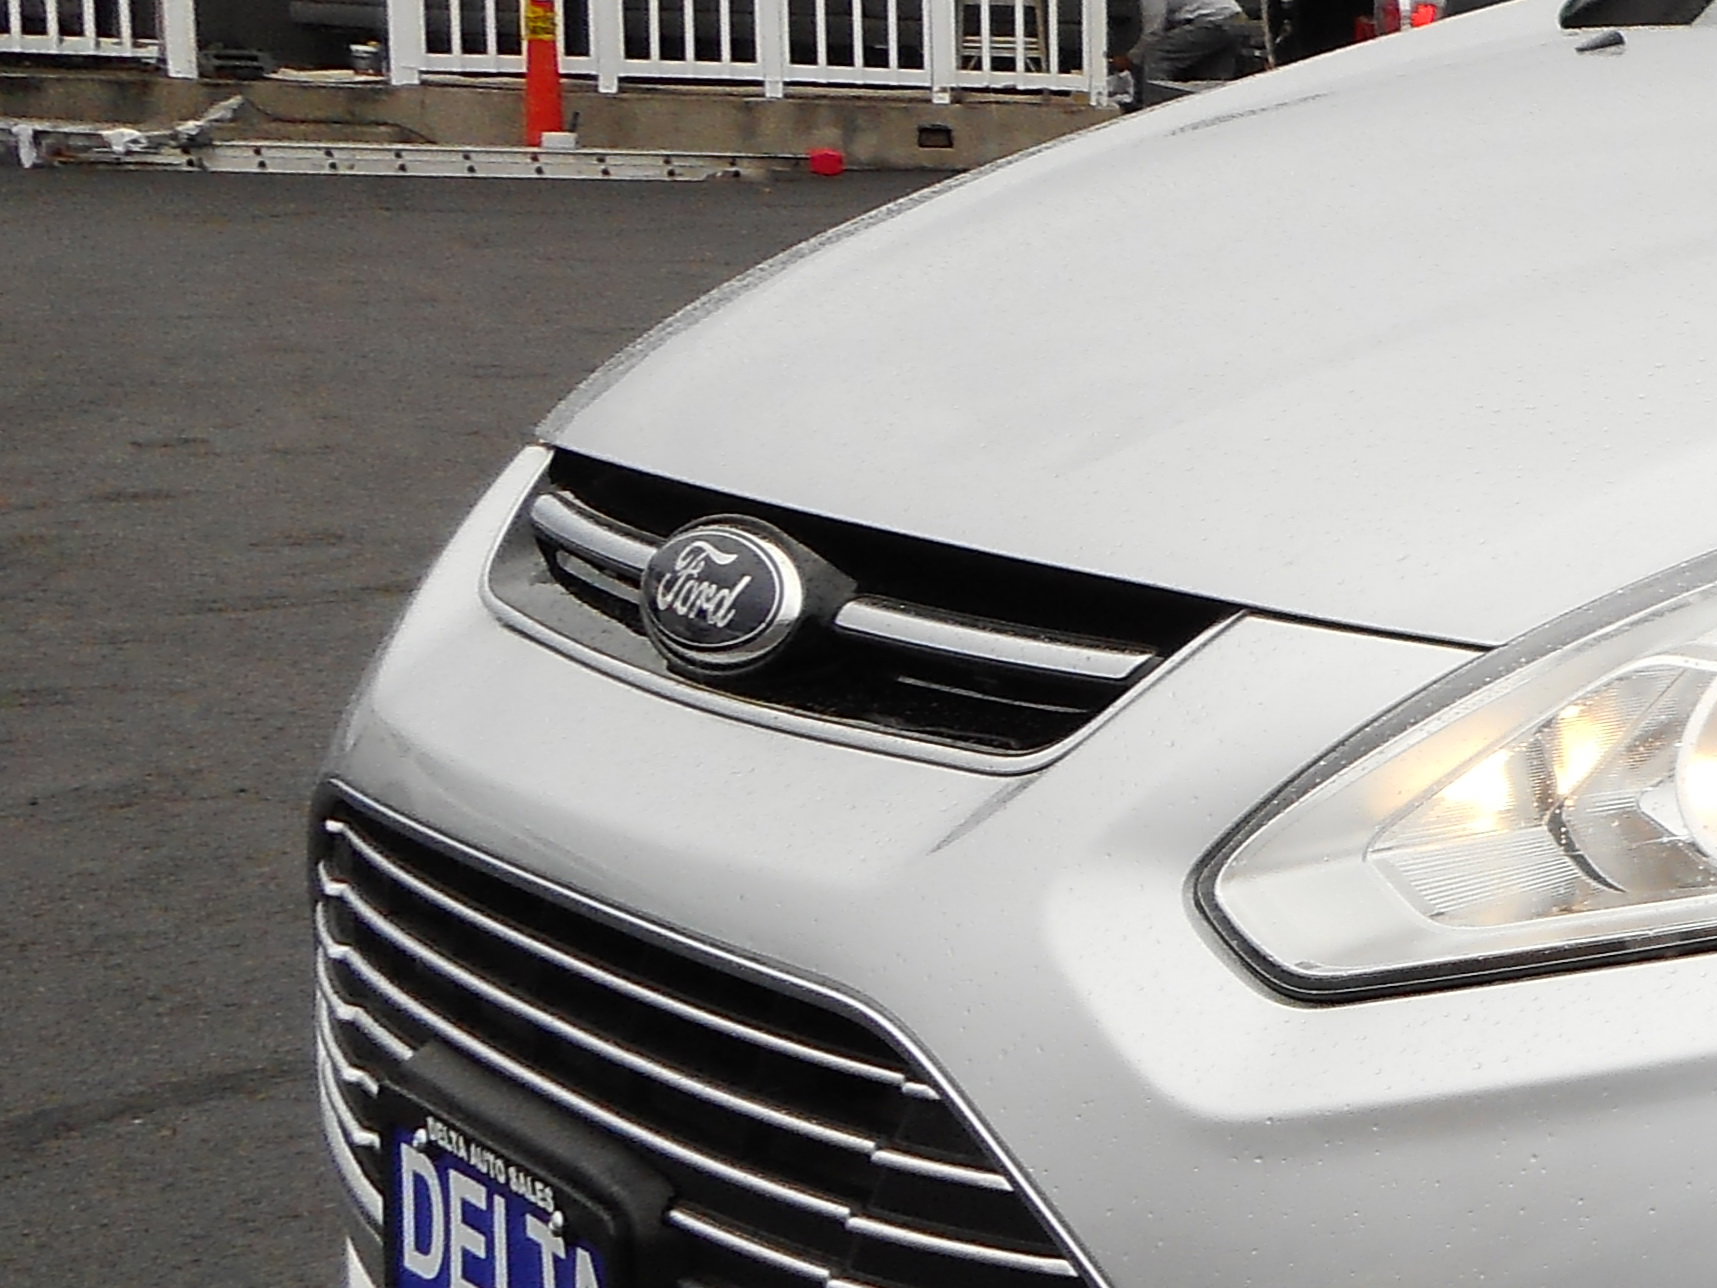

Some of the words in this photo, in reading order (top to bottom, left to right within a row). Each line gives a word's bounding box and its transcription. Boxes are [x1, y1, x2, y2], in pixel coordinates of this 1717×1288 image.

[656, 540, 752, 629] Ford
[426, 1116, 468, 1162] DELTA
[470, 1143, 506, 1185] AUTO
[508, 1166, 555, 1213] SALES
